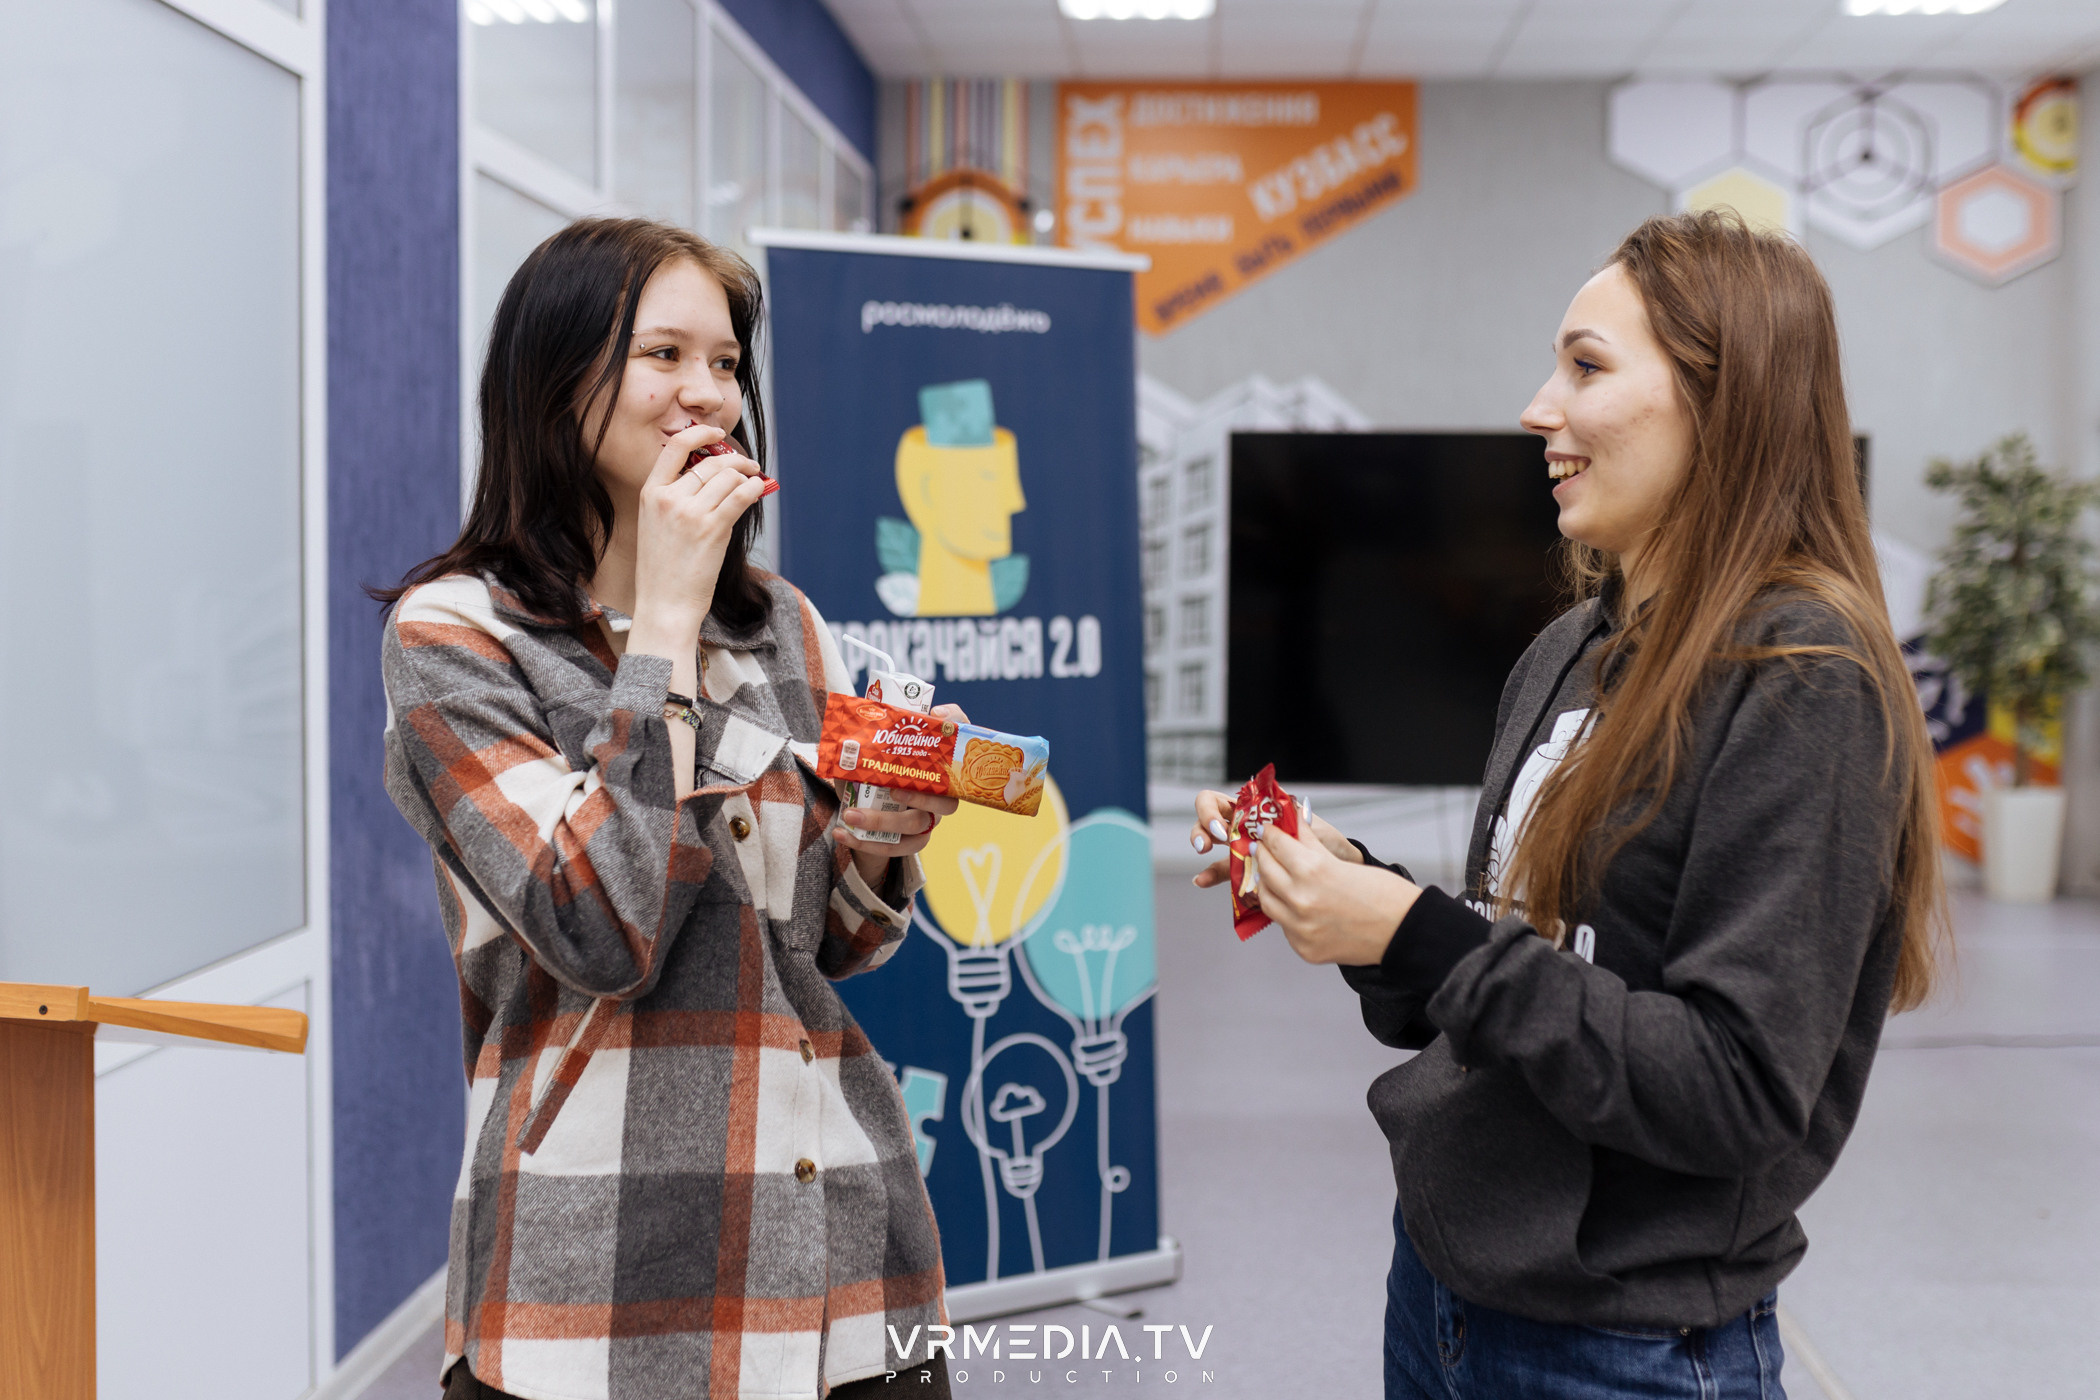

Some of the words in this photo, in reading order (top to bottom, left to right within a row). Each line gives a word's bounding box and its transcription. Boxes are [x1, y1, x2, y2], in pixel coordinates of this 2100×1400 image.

[1248, 111, 1409, 222] КУЗБАСС
[1049, 614, 1102, 679] 2.0
[872, 729, 941, 748] Юбилейное
[891, 746, 912, 756] 1913
[862, 757, 941, 783] ТРАДИЦИОННОЕ
